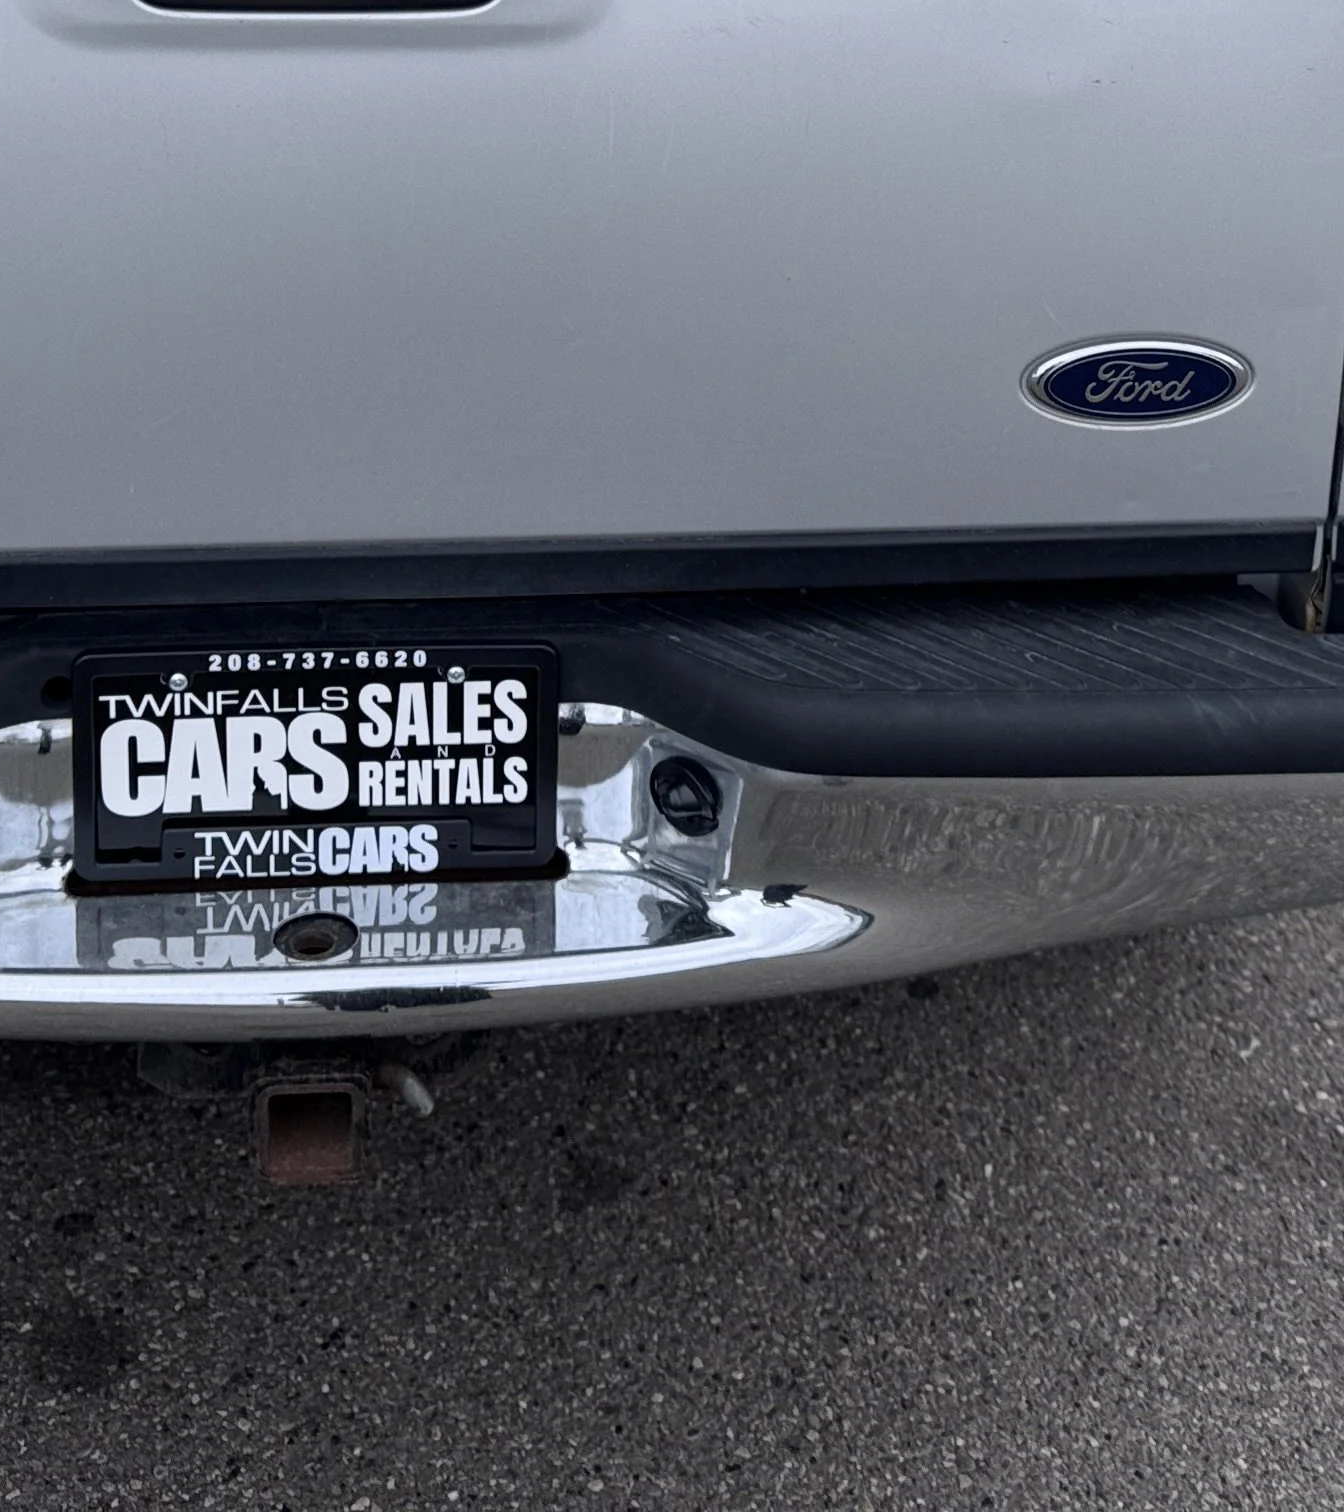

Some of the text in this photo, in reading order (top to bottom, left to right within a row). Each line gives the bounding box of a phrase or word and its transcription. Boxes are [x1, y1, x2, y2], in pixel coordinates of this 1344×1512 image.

[1085, 360, 1195, 403] Ford
[209, 650, 426, 672] 208-737-6620
[358, 679, 528, 748] SALES
[100, 712, 349, 817] CARS
[359, 756, 528, 807] RENTALS
[194, 829, 314, 856] TWIN
[194, 853, 316, 878] FALLS
[318, 824, 438, 875] CARS
